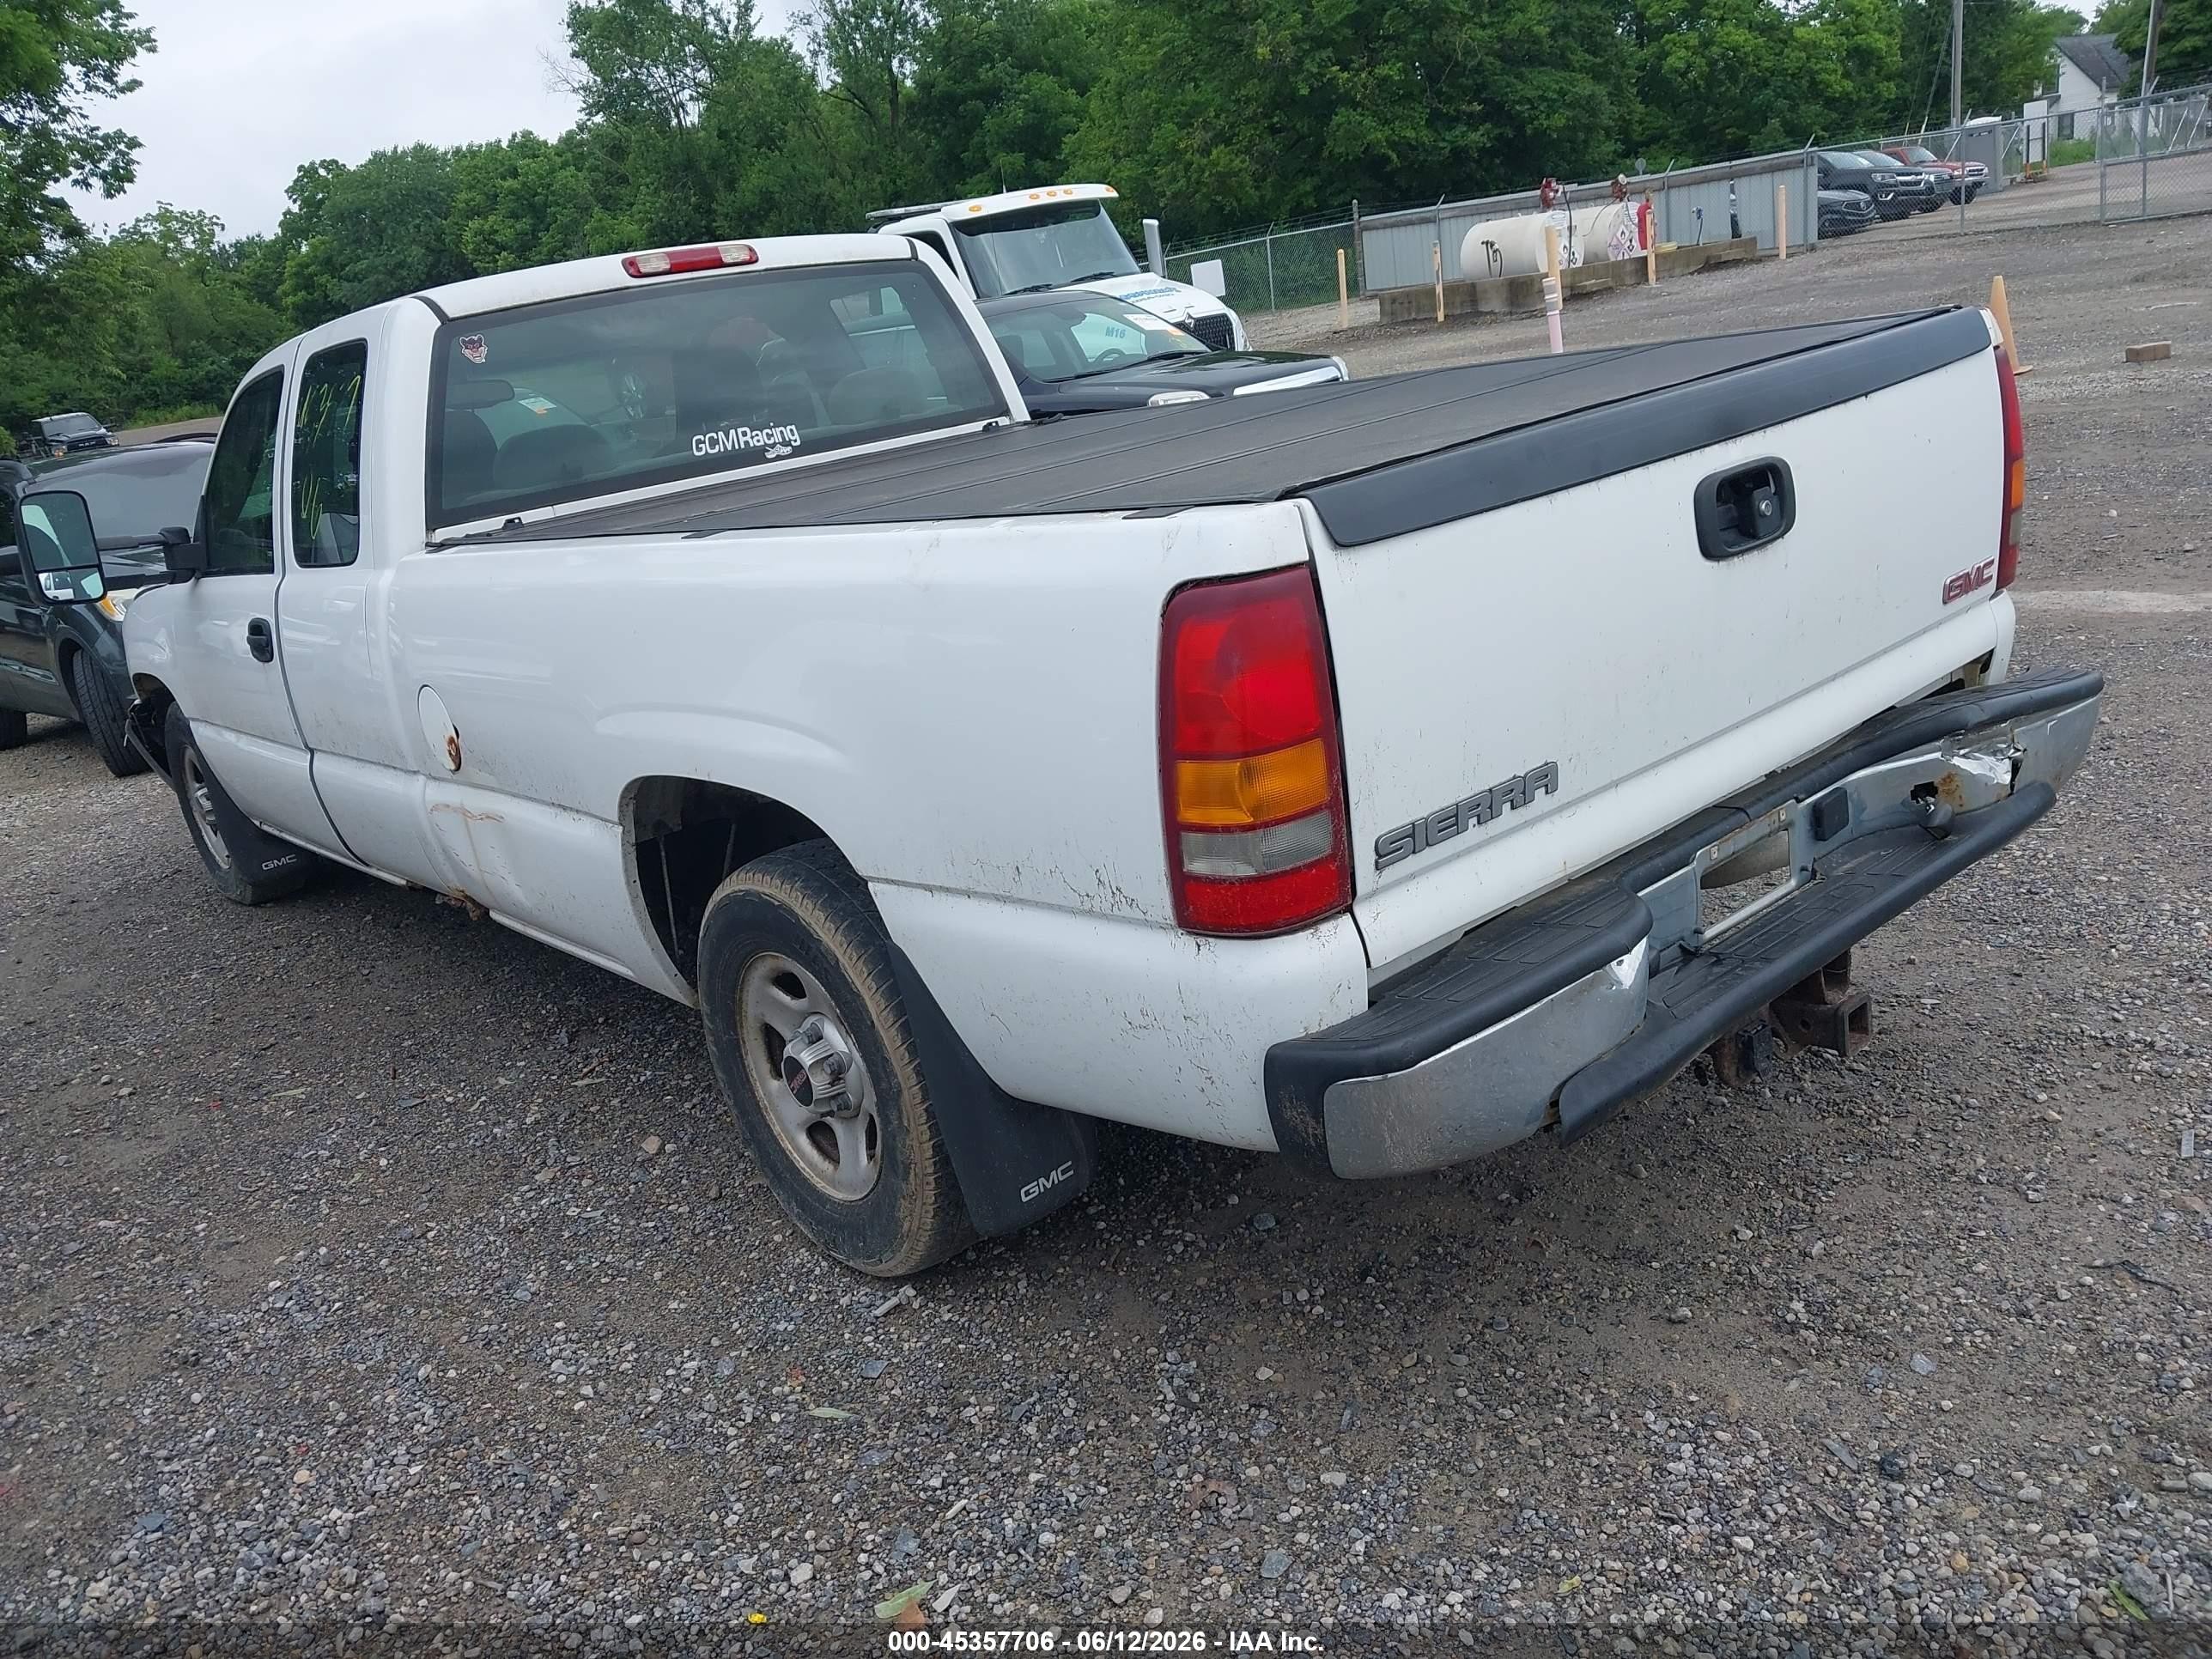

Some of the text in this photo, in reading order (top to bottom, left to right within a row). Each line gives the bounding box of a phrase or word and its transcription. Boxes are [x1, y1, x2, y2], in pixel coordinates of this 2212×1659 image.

[692, 422, 801, 456] GCMRacing
[1942, 556, 1995, 605] GMC
[1375, 762, 1559, 871] SIERRA
[261, 854, 298, 871] GMC
[1020, 1160, 1074, 1202] GMC
